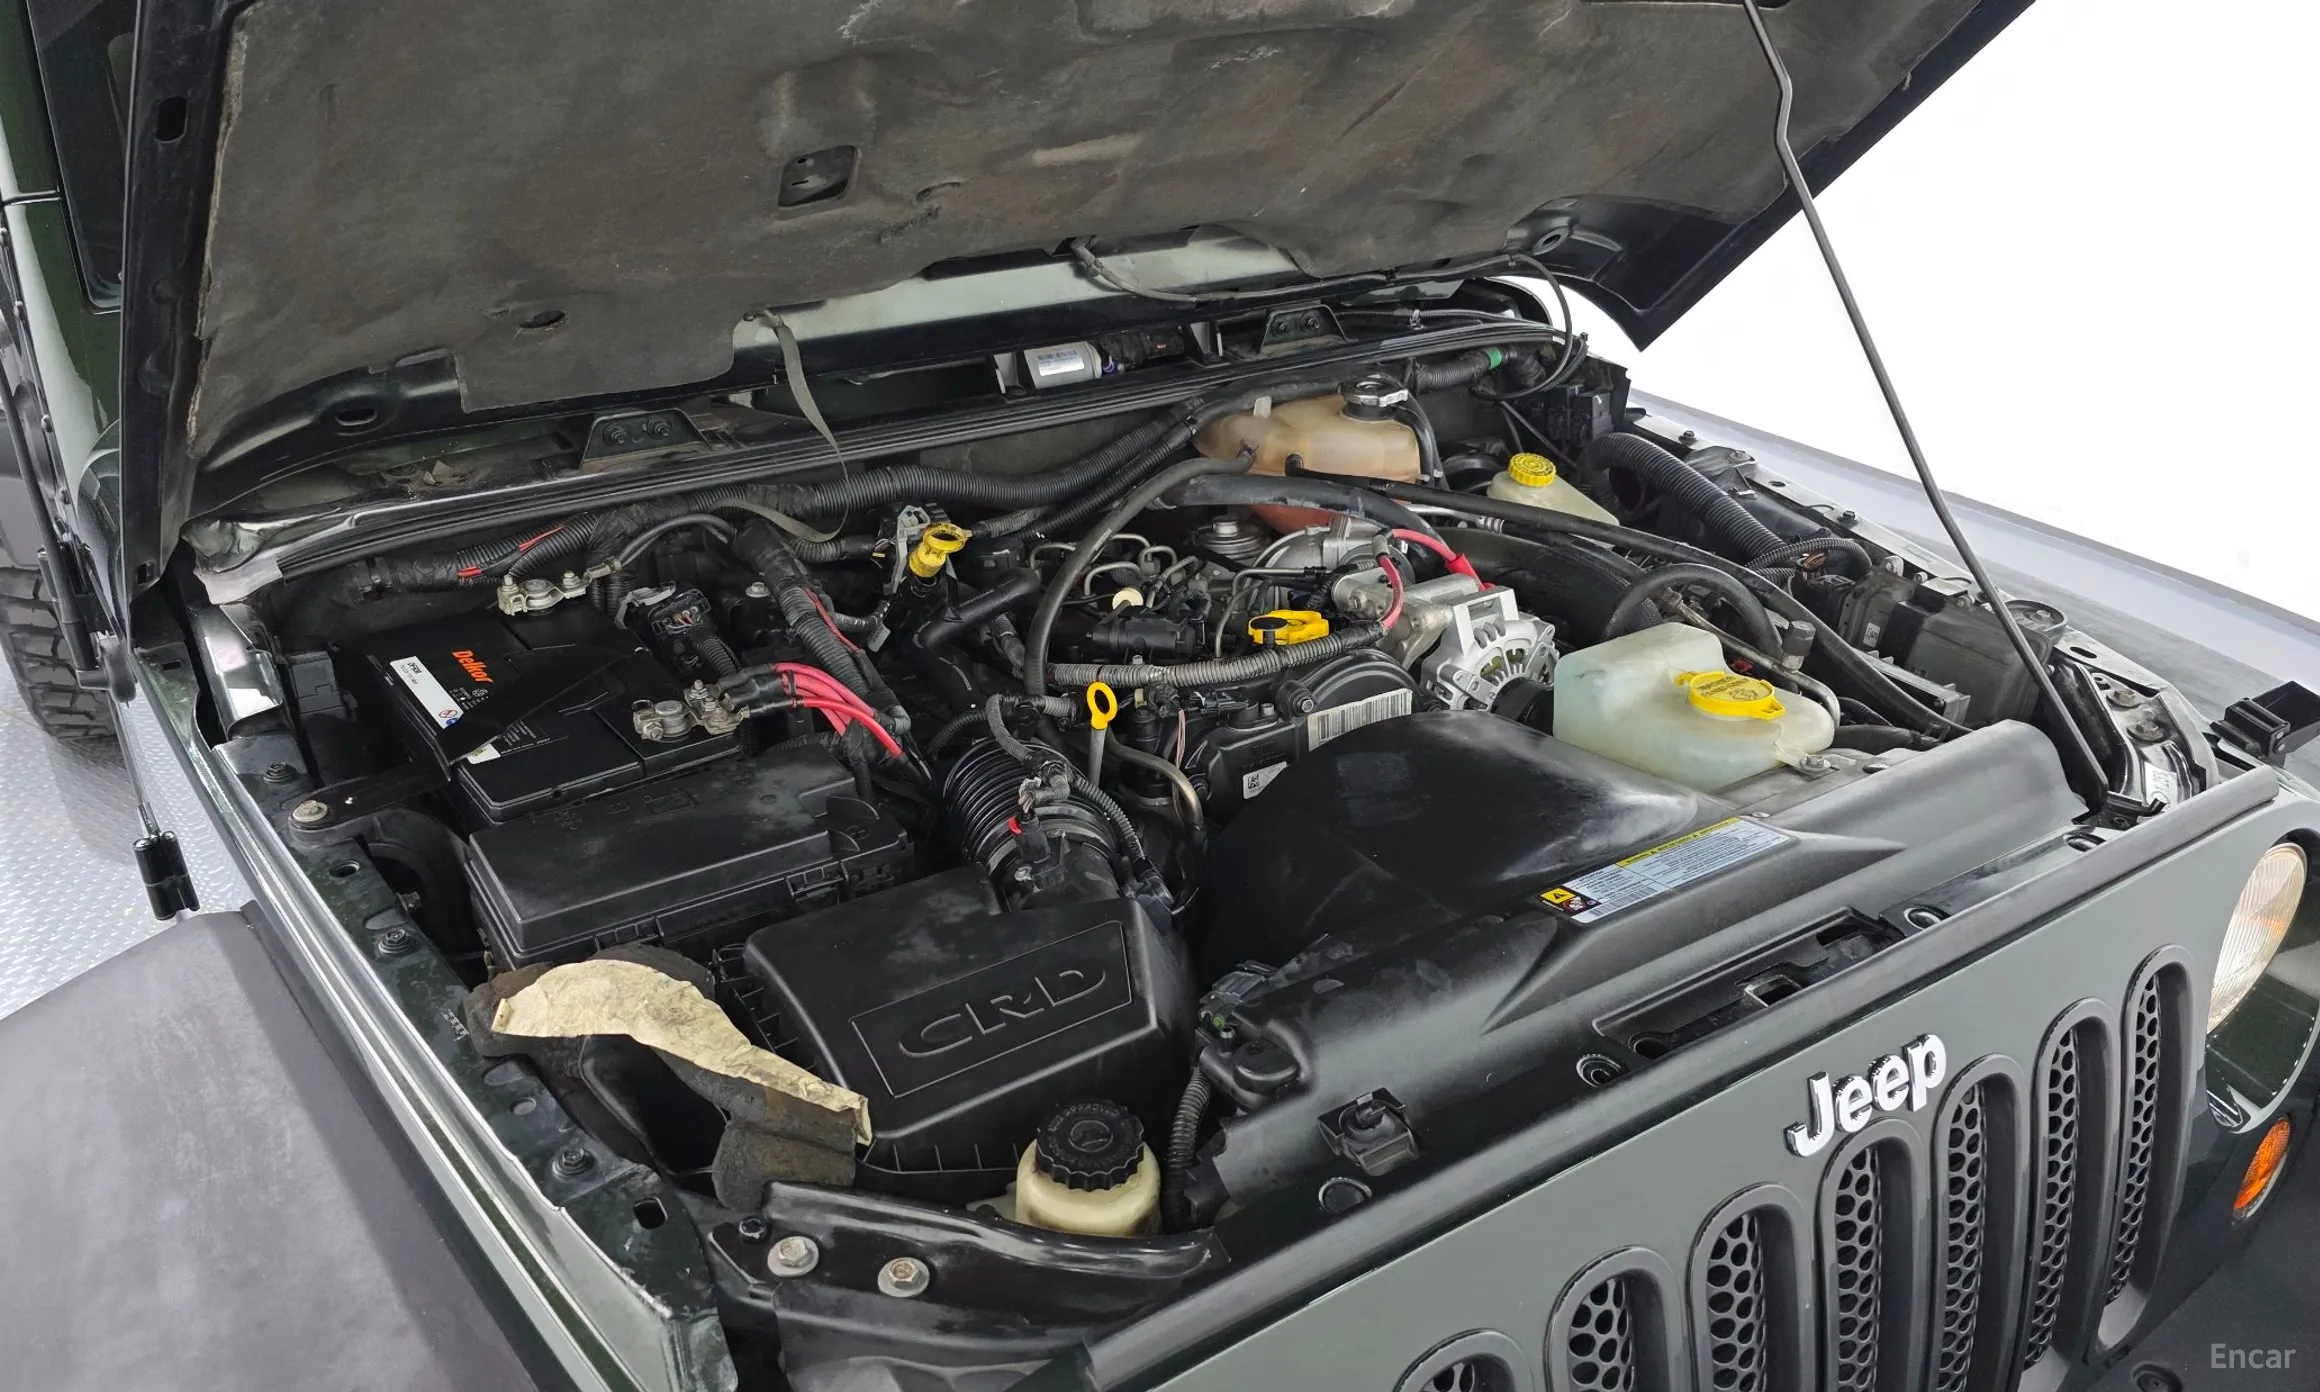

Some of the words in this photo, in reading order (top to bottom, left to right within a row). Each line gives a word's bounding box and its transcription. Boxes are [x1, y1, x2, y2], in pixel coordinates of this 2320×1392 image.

[452, 649, 495, 684] Delkor
[897, 967, 1106, 1058] CRD
[1783, 1032, 1947, 1158] Jeep
